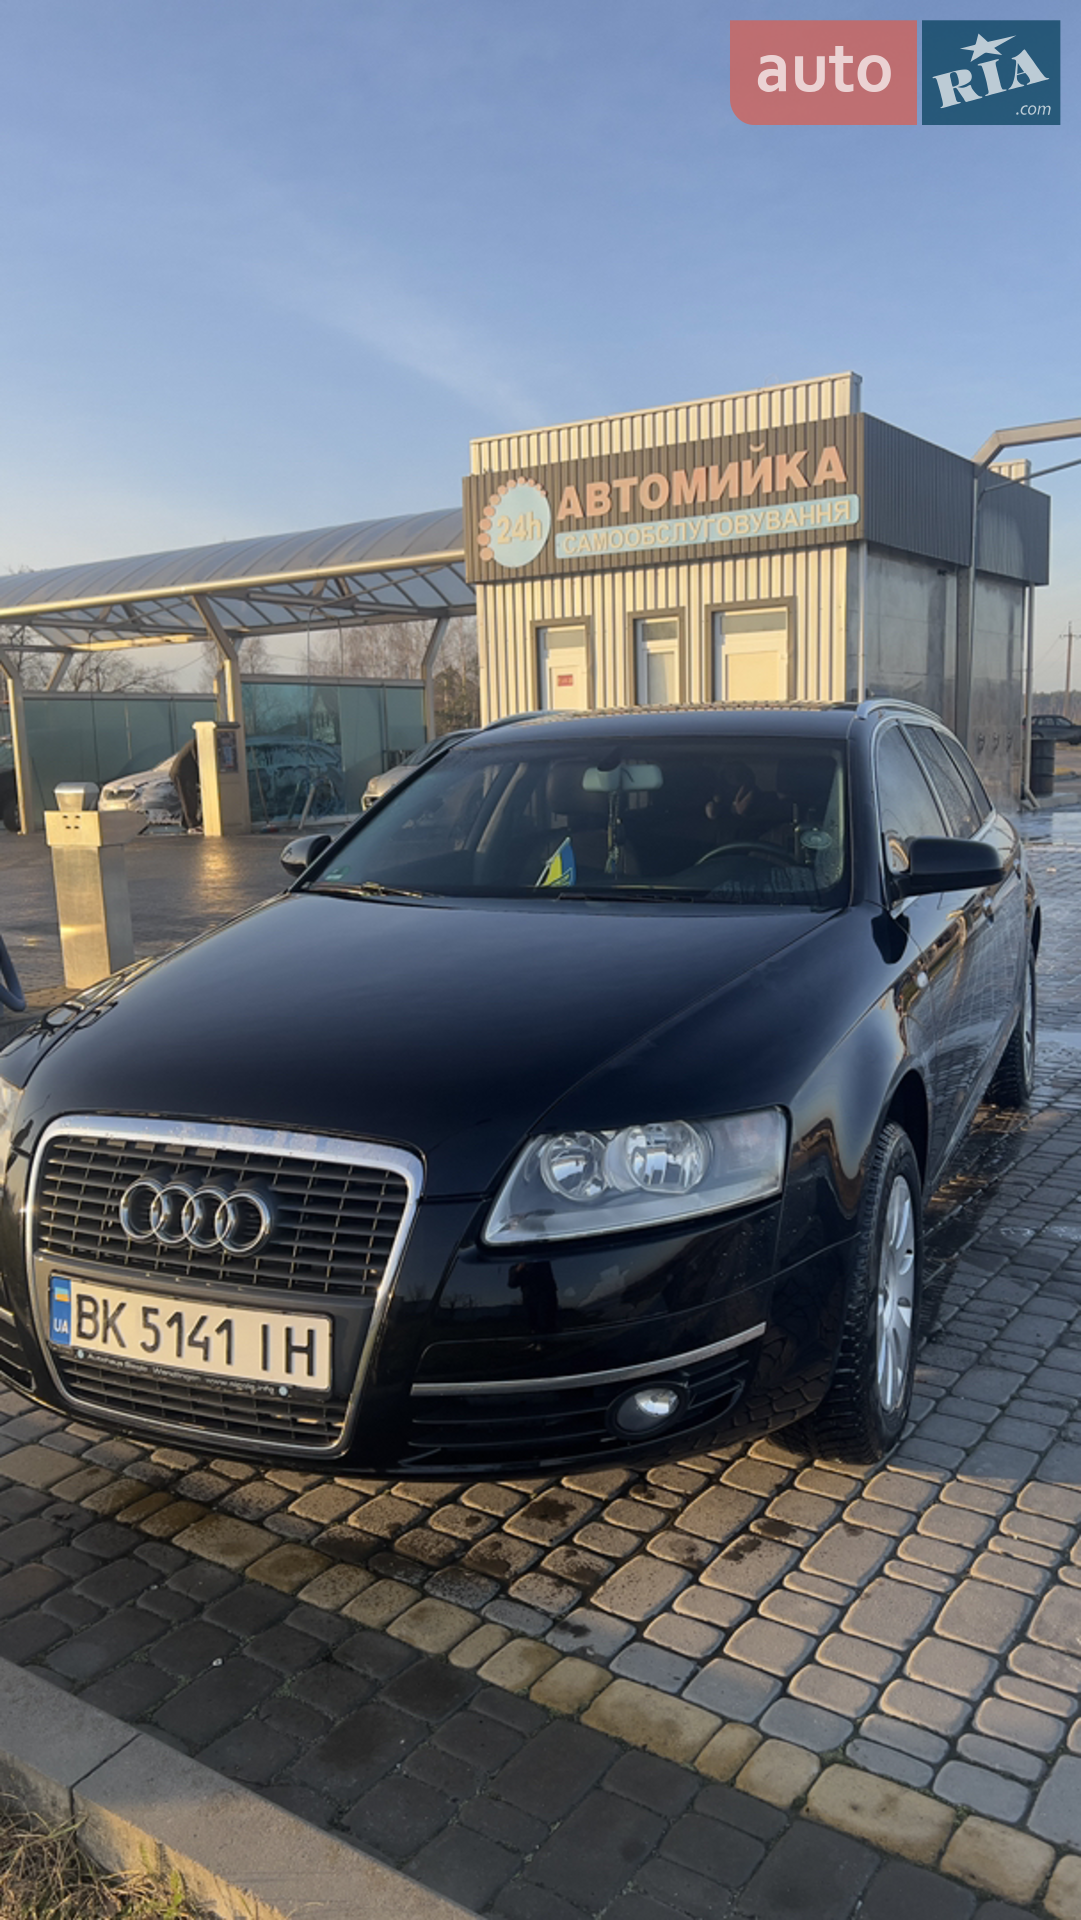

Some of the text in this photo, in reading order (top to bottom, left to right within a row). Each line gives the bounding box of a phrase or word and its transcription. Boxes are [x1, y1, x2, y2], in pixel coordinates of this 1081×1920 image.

[556, 442, 847, 520] АВТОМИЙКА
[496, 511, 542, 545] 24h
[562, 500, 852, 555] САМООБСЛУГОВУВАННЯ
[53, 1318, 69, 1334] UA
[76, 1293, 316, 1377] BK 5141 IH
